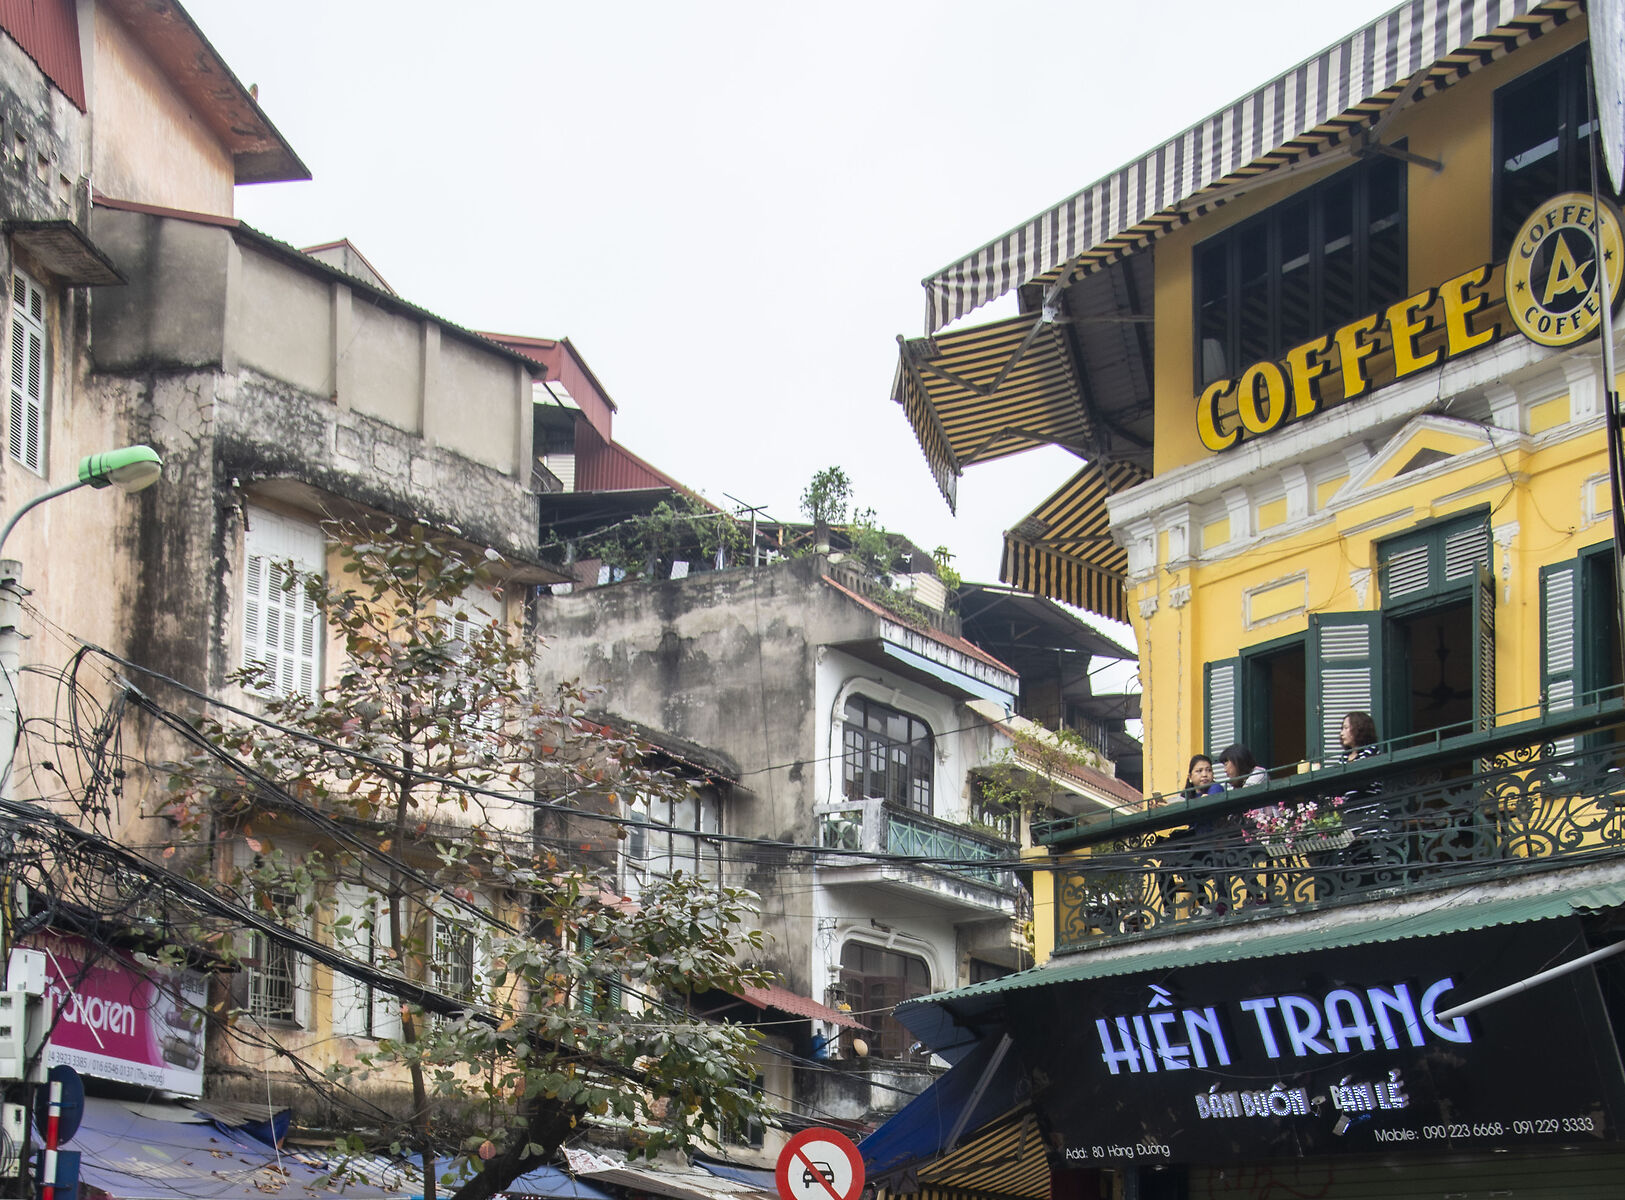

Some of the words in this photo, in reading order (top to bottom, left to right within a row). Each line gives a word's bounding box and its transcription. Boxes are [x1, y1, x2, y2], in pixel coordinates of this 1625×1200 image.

[1196, 264, 1497, 453] COFFEE
[1095, 984, 1232, 1075] HIỀN
[1239, 977, 1472, 1059] TRANG
[1195, 1083, 1240, 1119] BÁN
[1241, 1083, 1308, 1118] BUÔN
[1374, 1128, 1420, 1143] Mobile:
[1423, 1125, 1447, 1140] 090
[1448, 1123, 1471, 1138] 223
[1473, 1121, 1504, 1137] 6668
[1513, 1120, 1535, 1135] 091
[1535, 1118, 1559, 1134] 229
[1562, 1116, 1595, 1132] 3333
[1065, 1147, 1089, 1160] Add:
[1091, 1146, 1105, 1158] 80
[1107, 1144, 1134, 1159] Hàng
[1136, 1142, 1171, 1158] Đường
